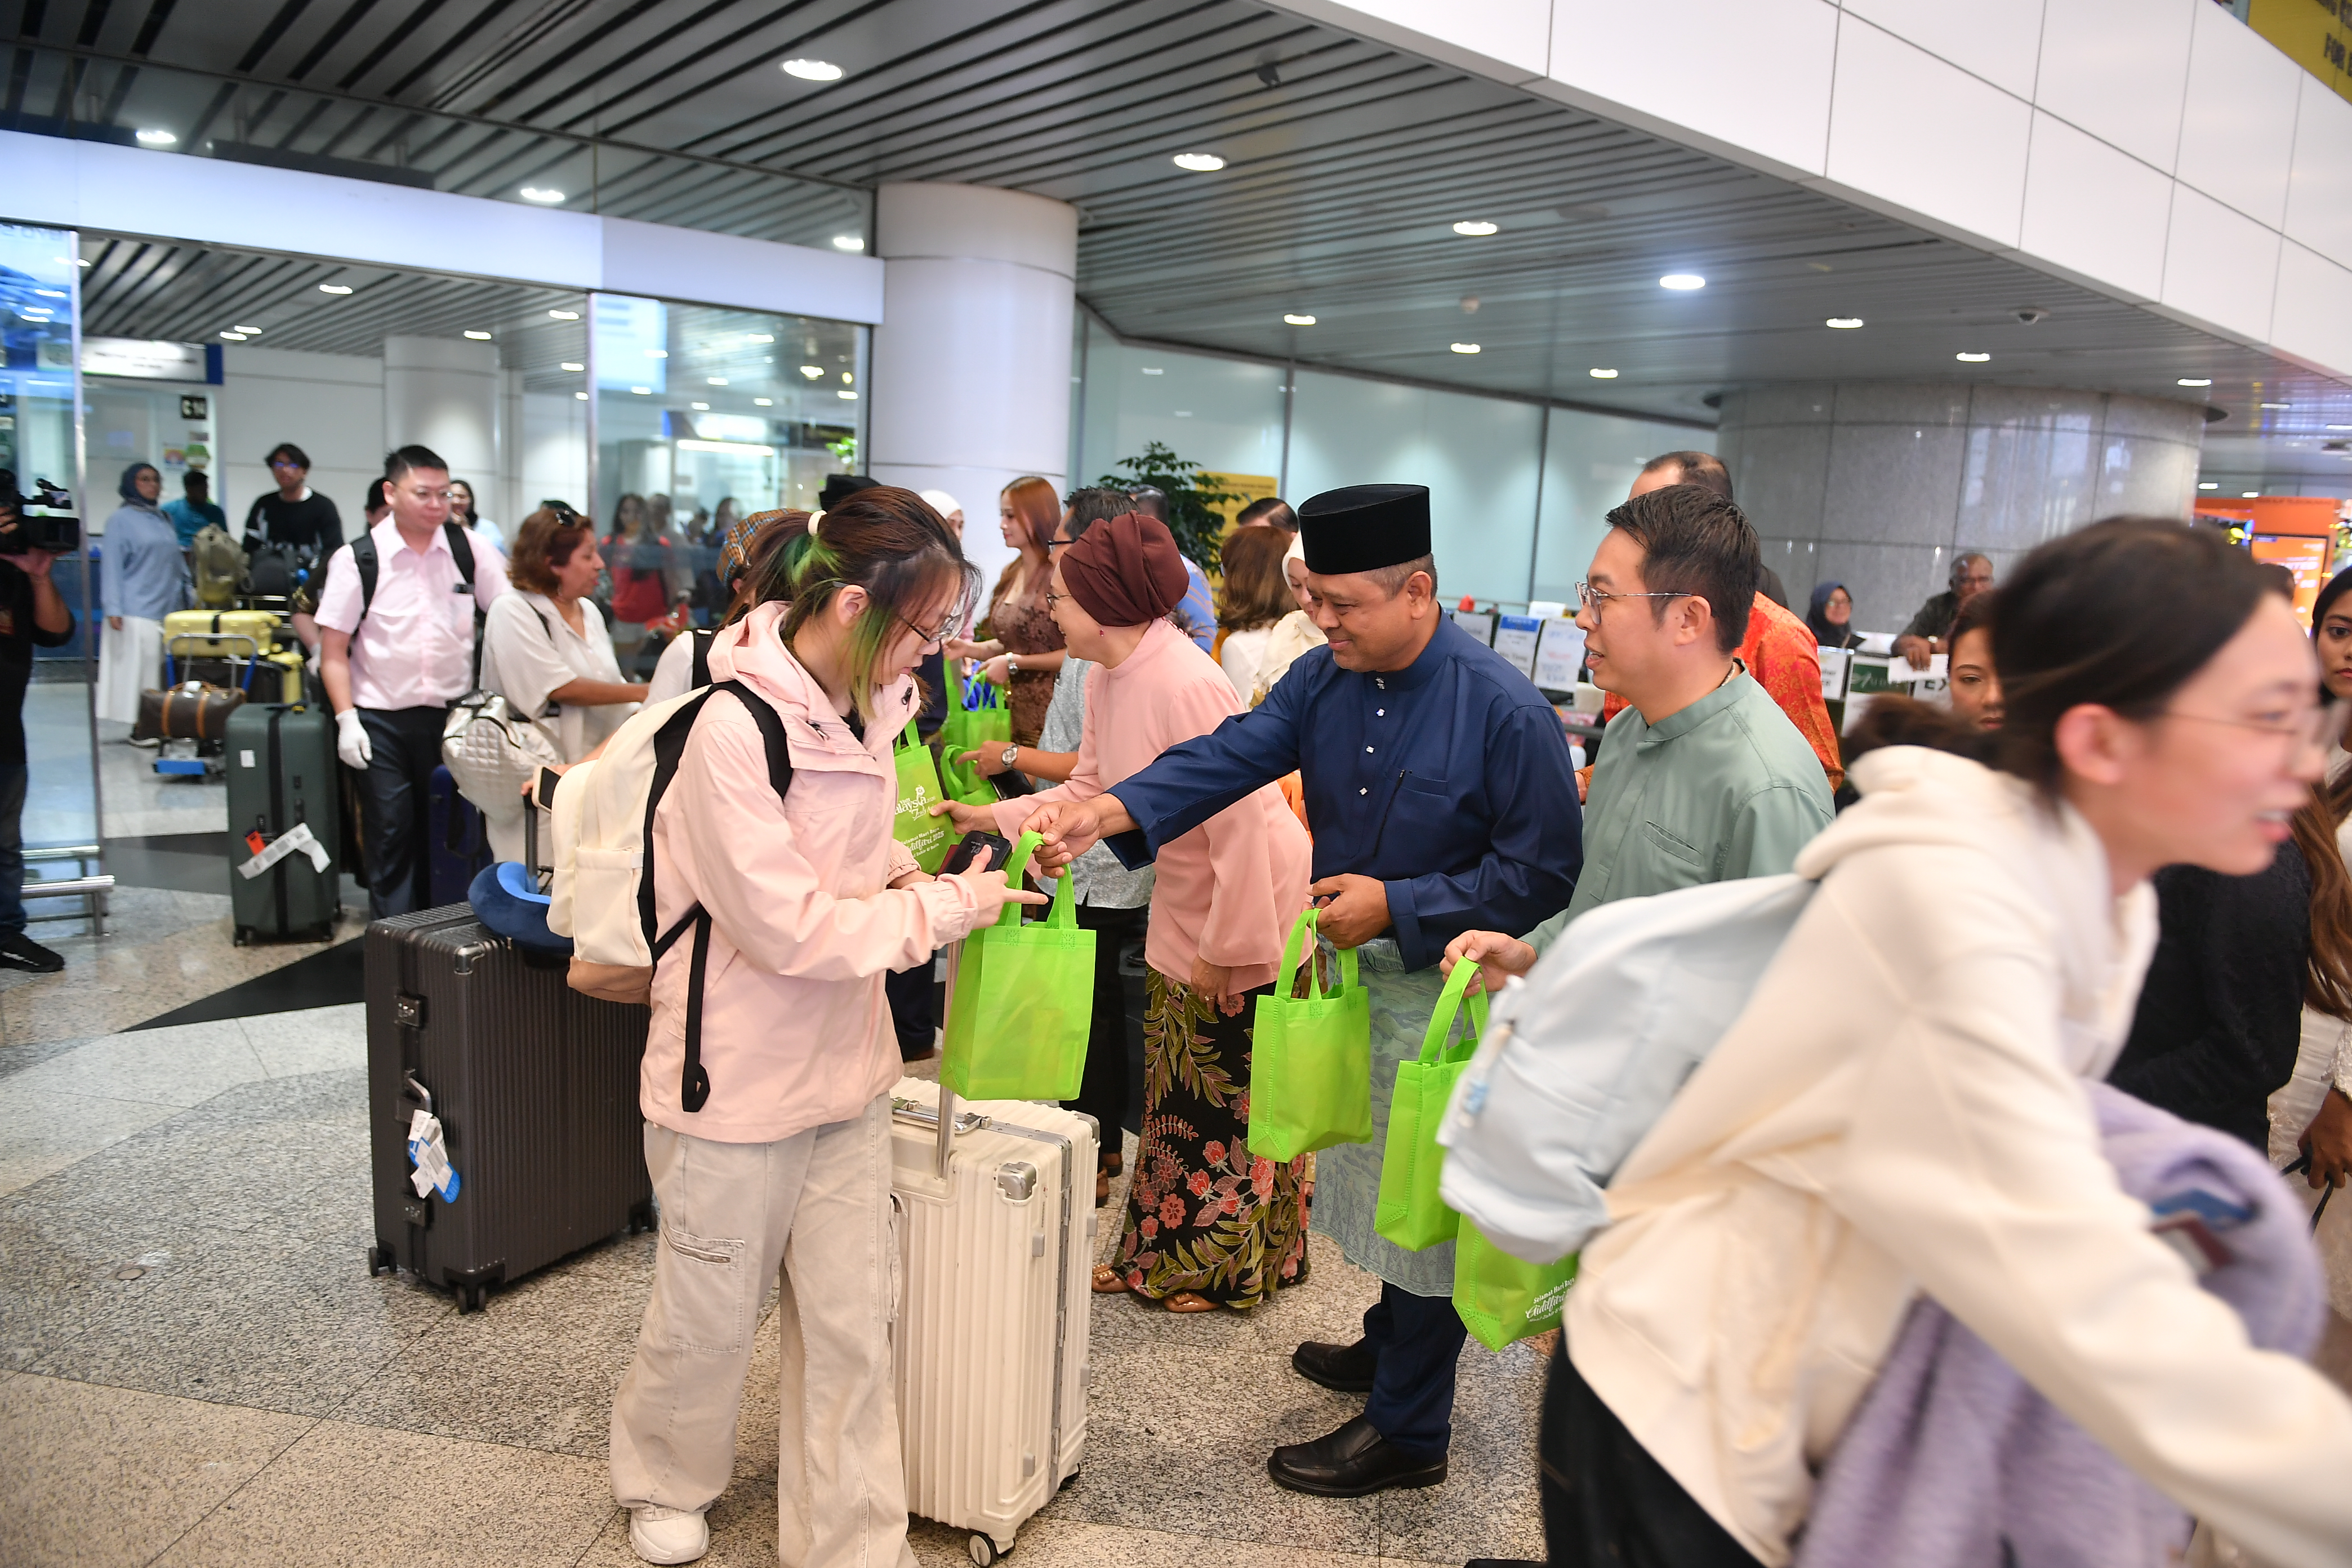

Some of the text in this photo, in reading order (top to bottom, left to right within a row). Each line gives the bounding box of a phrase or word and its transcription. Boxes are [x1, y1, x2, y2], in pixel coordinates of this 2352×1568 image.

[894, 795, 927, 815] alaysia
[1533, 1289, 1553, 1304] Selamat
[1553, 1282, 1564, 1294] Hari
[1525, 1291, 1566, 1318] Aidilfitri
